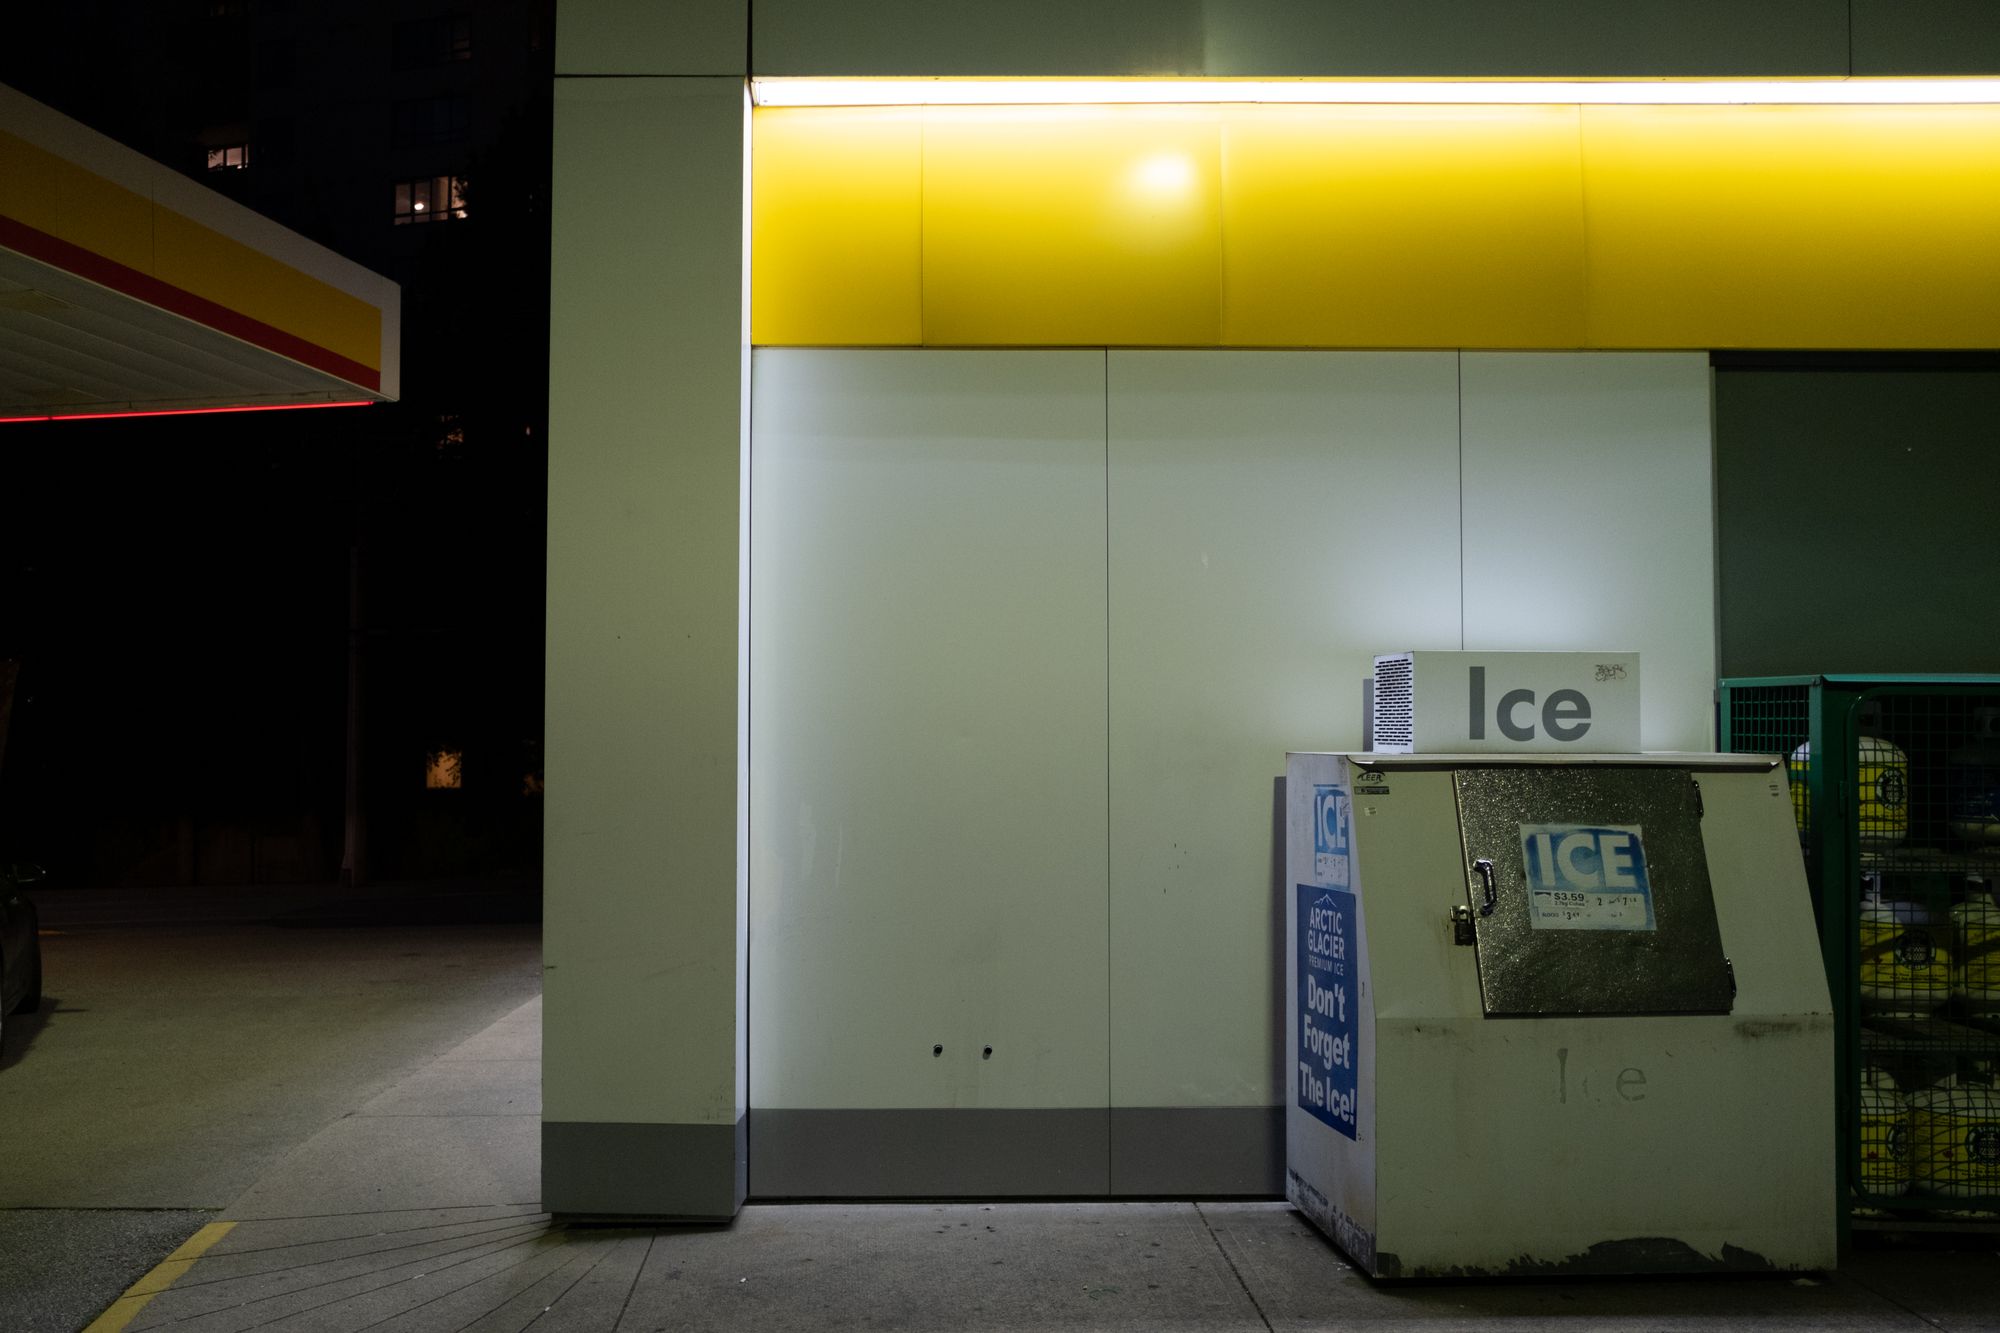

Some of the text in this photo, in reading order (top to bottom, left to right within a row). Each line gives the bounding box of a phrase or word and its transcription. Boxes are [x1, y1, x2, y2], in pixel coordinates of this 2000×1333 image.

[1469, 666, 1592, 742] Ice
[1316, 794, 1348, 849] ICE
[1536, 832, 1638, 888] ICE
[1309, 908, 1343, 935] ARCTIC
[1554, 892, 1585, 902] $3.59
[1308, 931, 1345, 961] GLACIER
[1308, 955, 1344, 976] PREMIUM ICE
[1307, 974, 1345, 1022] Don't
[1304, 1014, 1350, 1070] Forget
[1300, 1062, 1355, 1126] The Ice!
[1557, 1048, 1647, 1104] Ie
